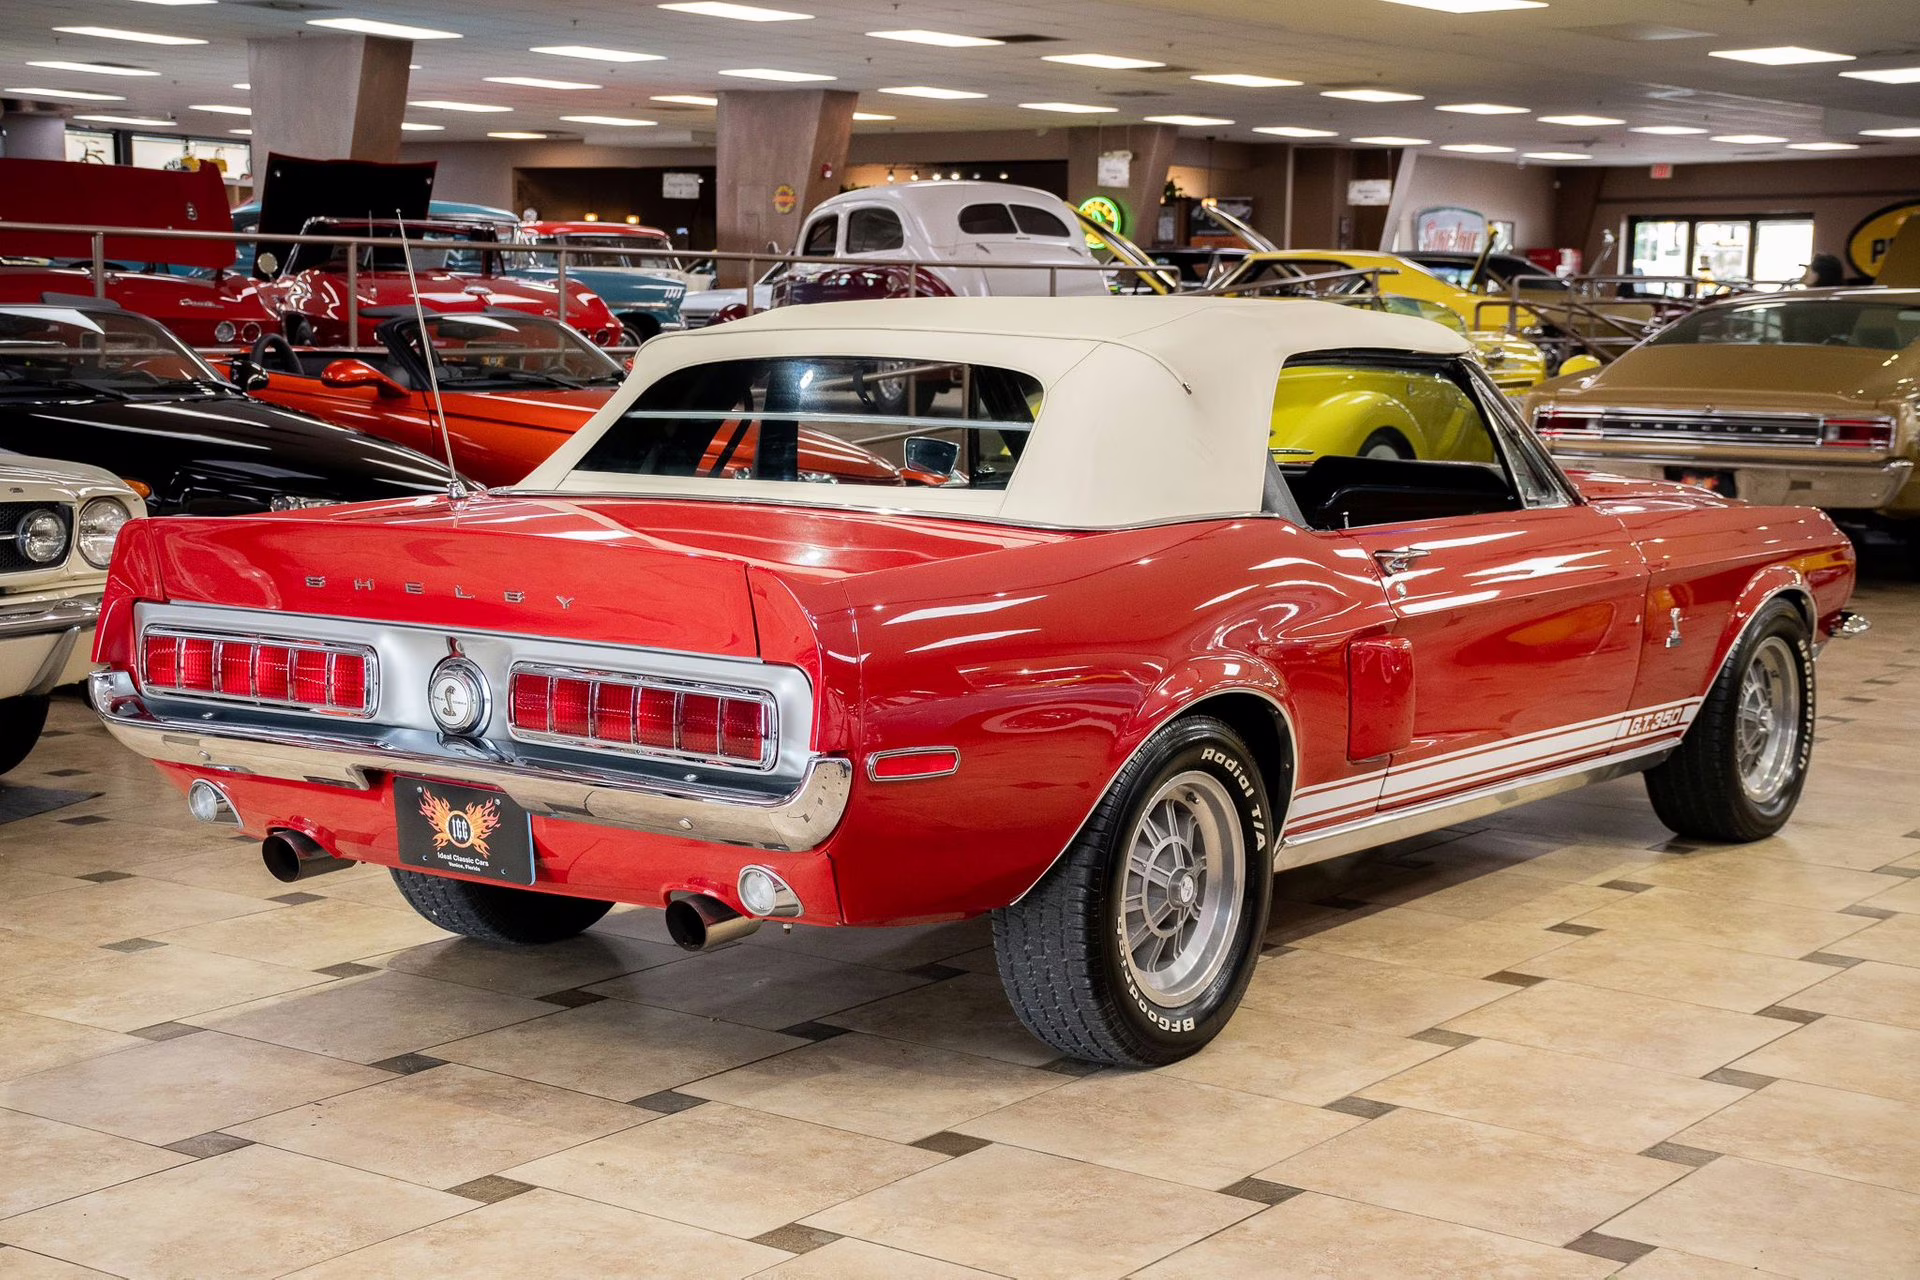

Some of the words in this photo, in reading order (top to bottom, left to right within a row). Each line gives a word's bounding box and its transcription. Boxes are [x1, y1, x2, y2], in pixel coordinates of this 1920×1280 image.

[1629, 422, 1788, 434] MERCURY
[305, 575, 575, 610] SHELBY
[1201, 748, 1255, 798] Radial
[1251, 803, 1266, 852] T/A
[437, 852, 452, 860] Ideal
[453, 854, 474, 864] Classic
[475, 858, 489, 867] Cars
